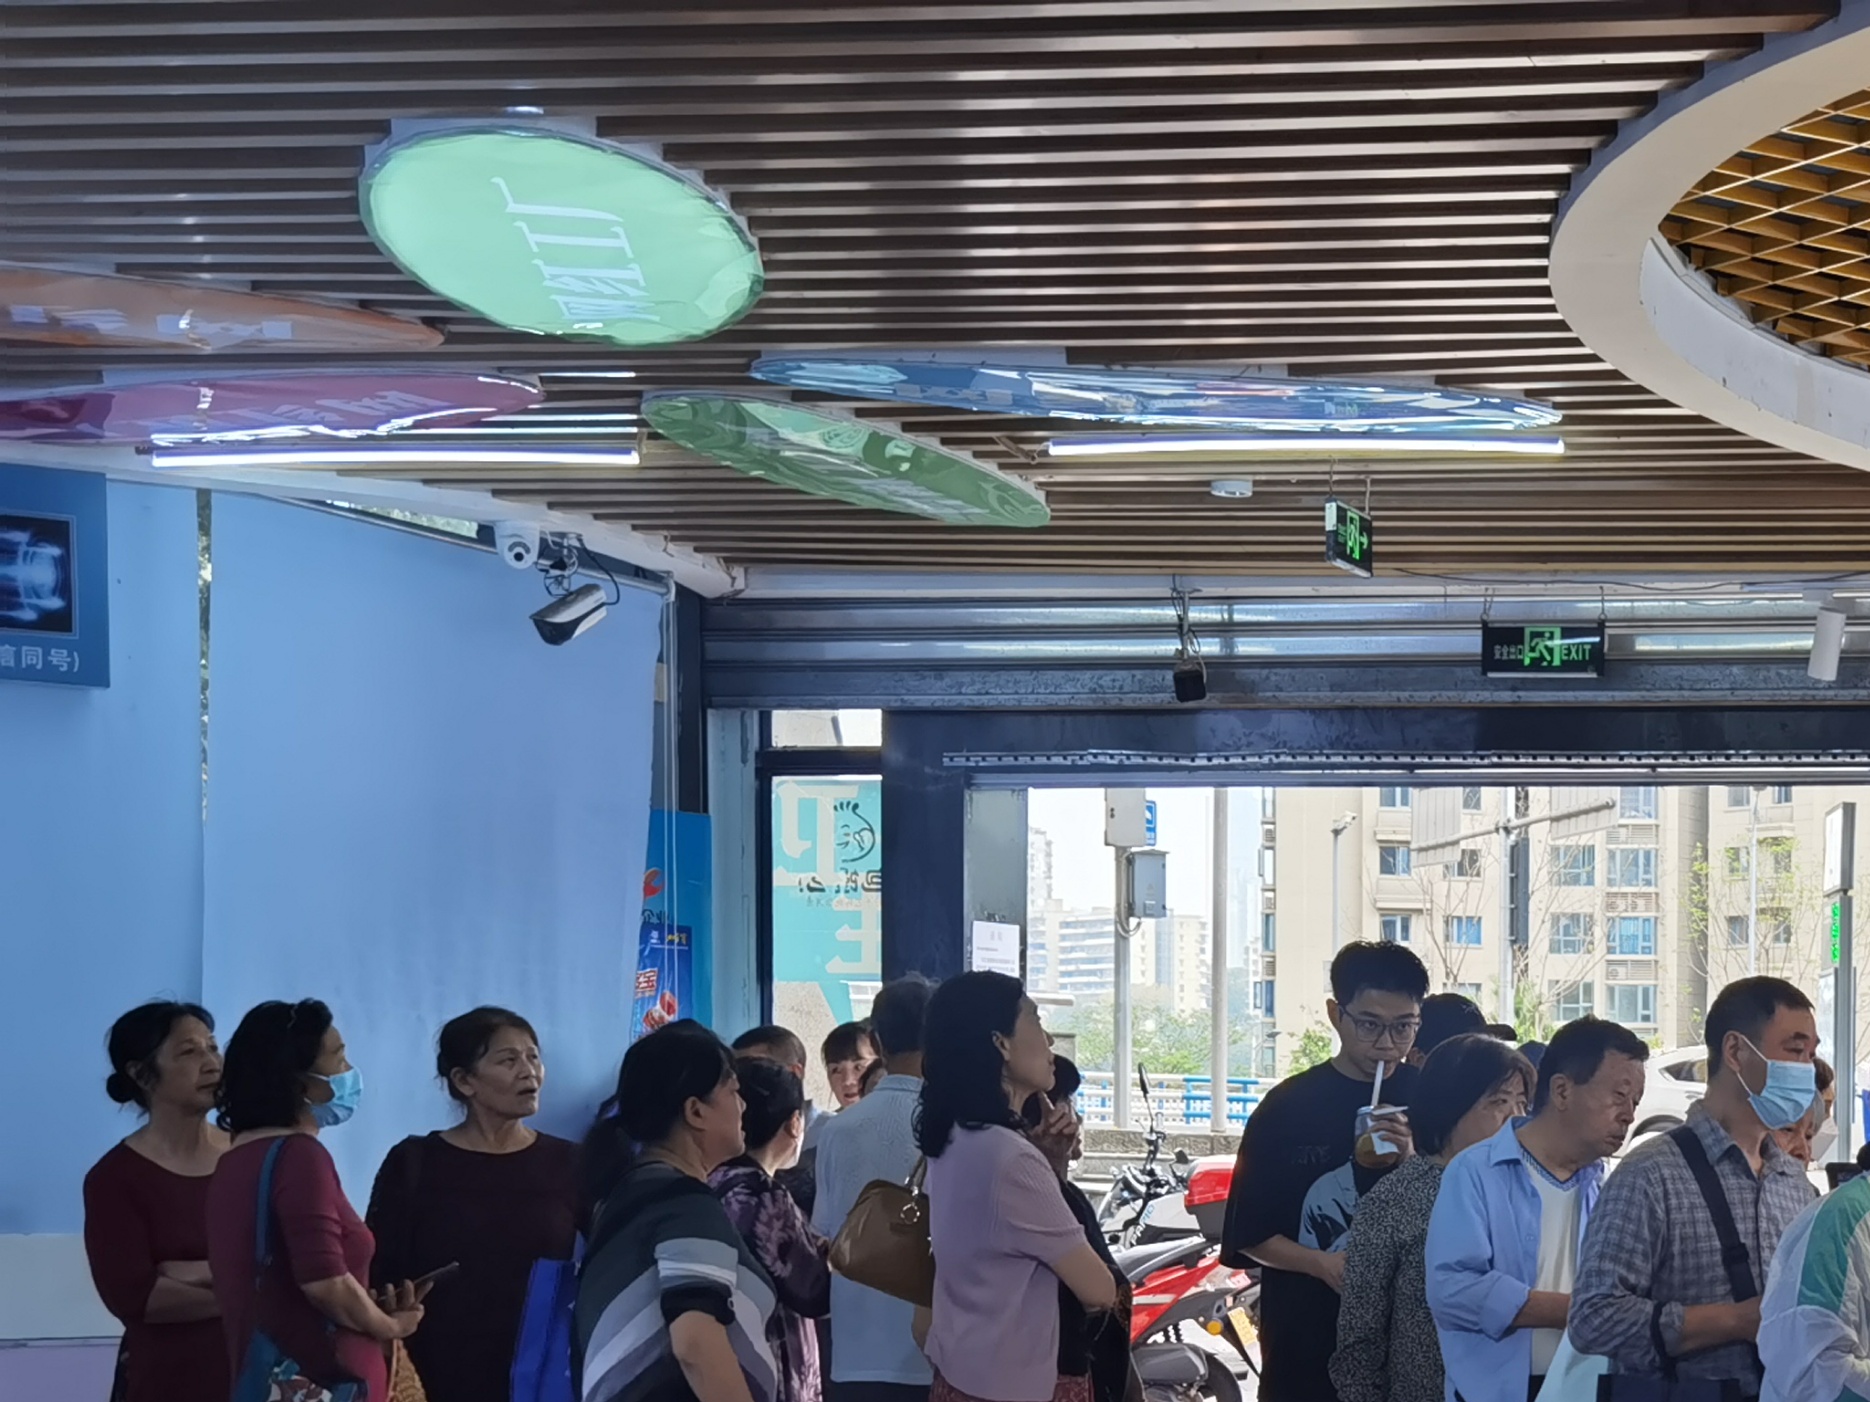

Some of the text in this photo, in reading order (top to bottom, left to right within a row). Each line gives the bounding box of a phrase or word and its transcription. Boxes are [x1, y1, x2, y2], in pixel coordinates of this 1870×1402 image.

[1494, 645, 1591, 660] 安全出口 EXIT
